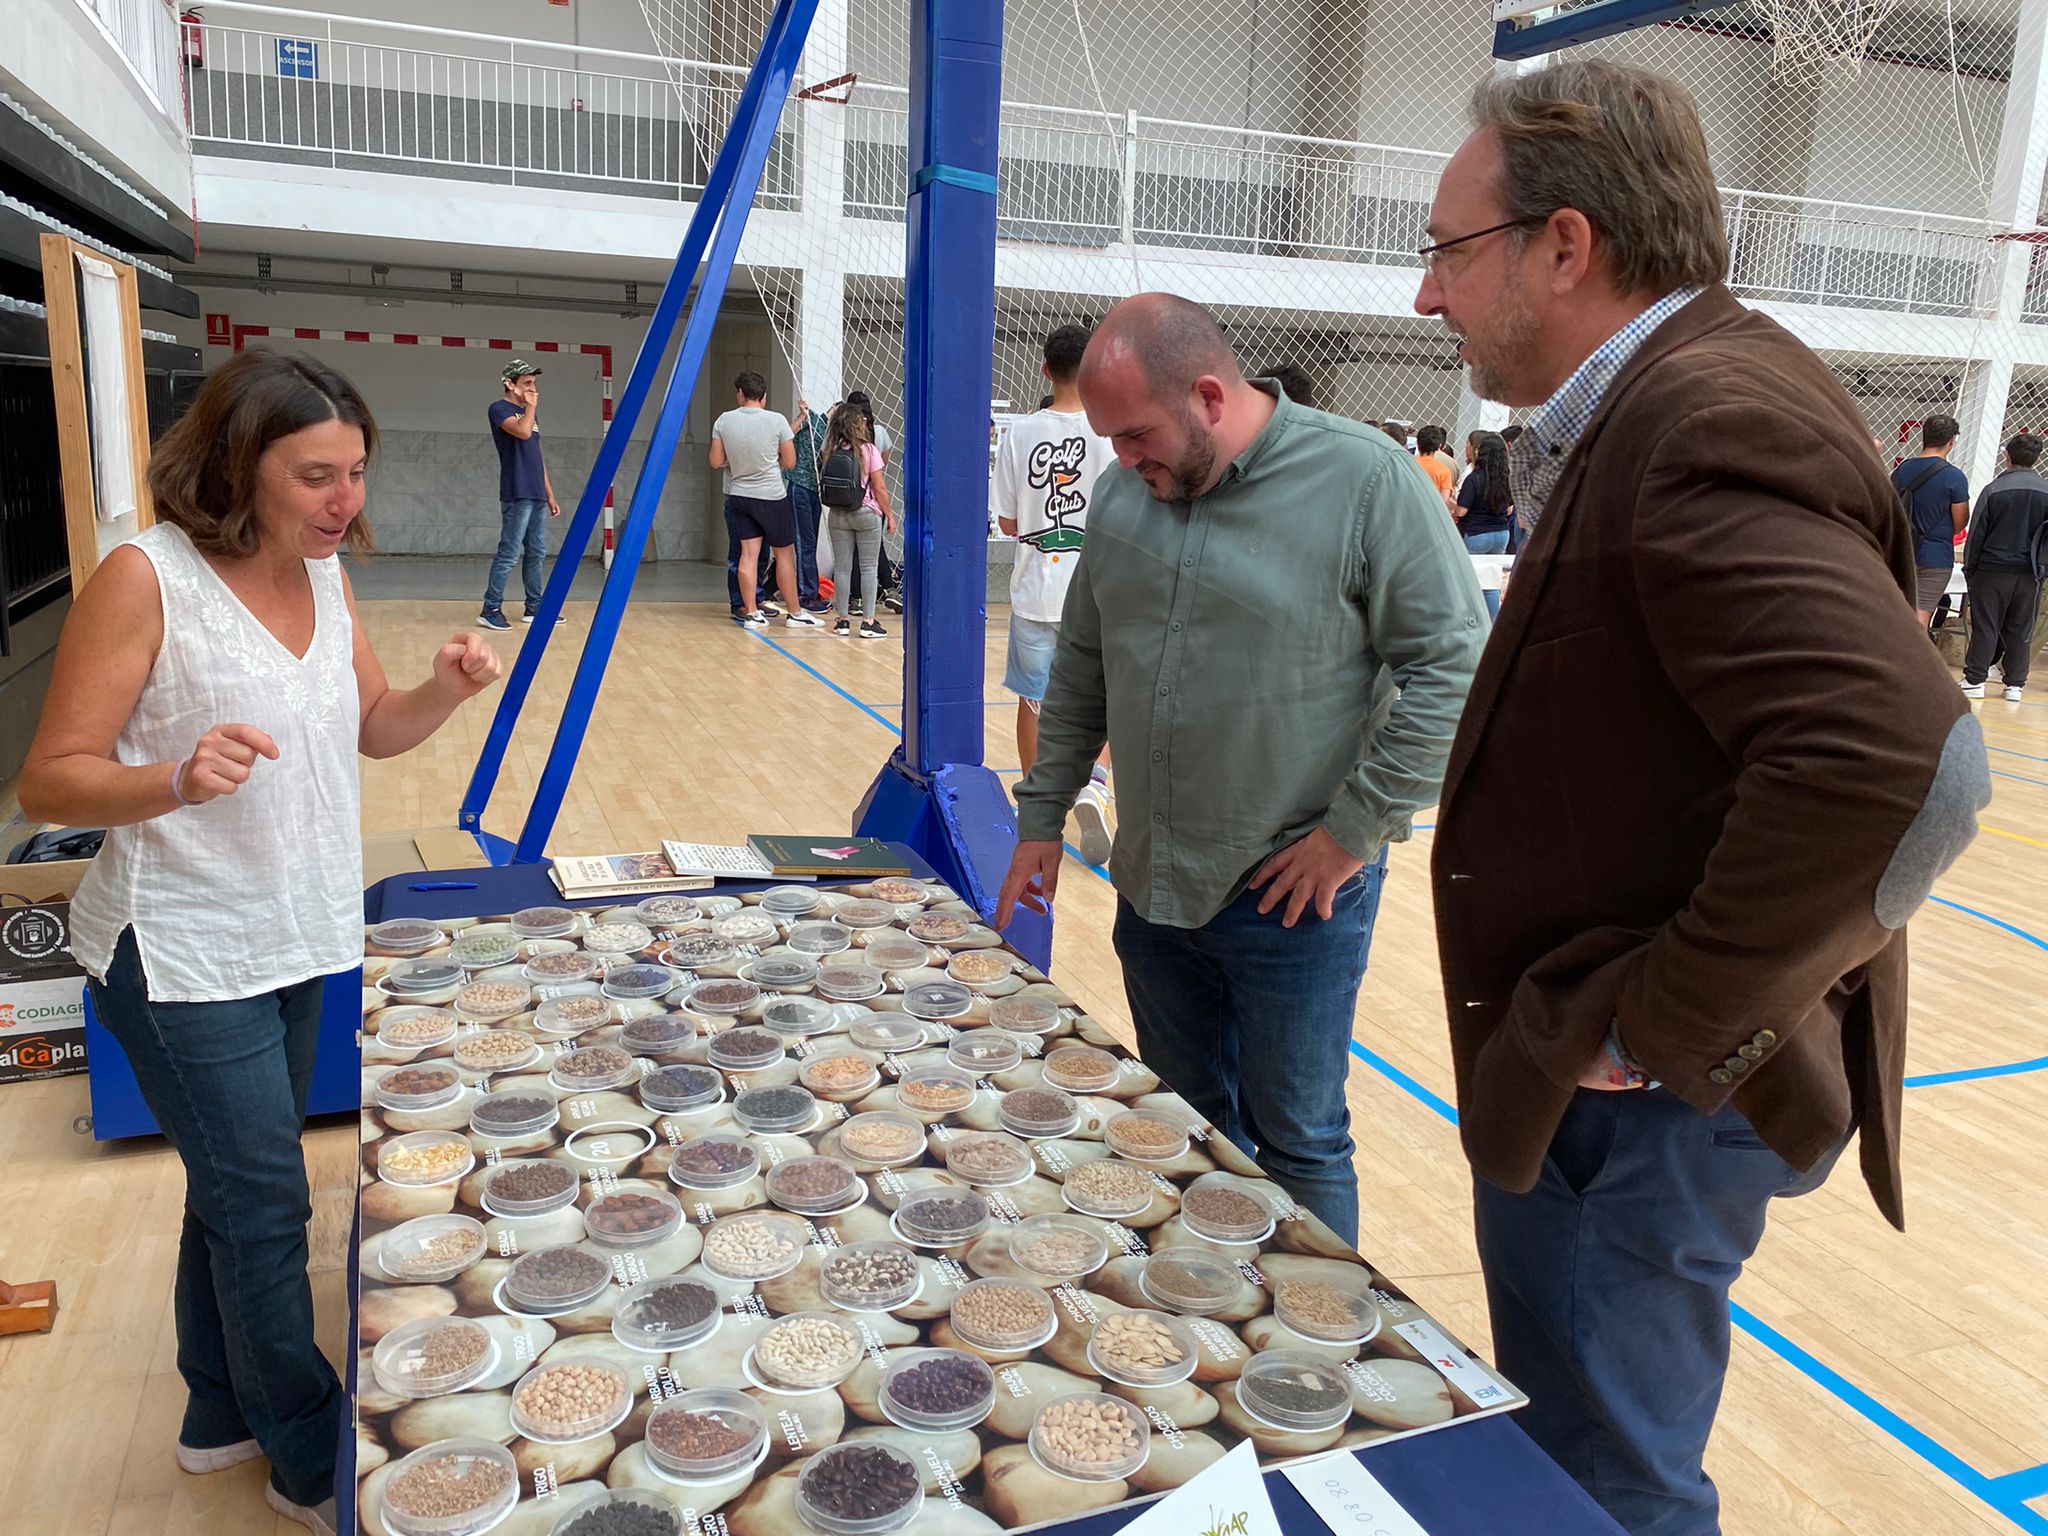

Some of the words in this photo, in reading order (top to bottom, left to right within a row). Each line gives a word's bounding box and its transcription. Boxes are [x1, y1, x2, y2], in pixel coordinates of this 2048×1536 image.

[1030, 438, 1085, 488] Golf
[1047, 492, 1085, 516] Club
[590, 1141, 610, 1156] 20
[1034, 1145, 1061, 1173] CALABAZA
[599, 1166, 614, 1194] OLORADO
[694, 1202, 709, 1224] HABAS
[985, 1195, 1009, 1224] CHOCHOS
[498, 1230, 511, 1256] CEBADA
[1104, 1225, 1136, 1259] CALABAZA
[624, 1252, 639, 1285] OLORADO
[940, 1254, 960, 1278] CARITA
[731, 1294, 752, 1327] LENTEJA
[1053, 1287, 1086, 1324] CHOCHOS
[1063, 1281, 1100, 1325] SILVESTRES
[513, 1335, 527, 1360] TRIGO
[856, 1319, 887, 1370] HABICHUELA
[1190, 1323, 1228, 1361] BUBANGO
[1201, 1321, 1240, 1359] AMARILLO
[643, 1364, 664, 1410] ARBANZO
[658, 1366, 677, 1399] RIOLLO
[1000, 1368, 1025, 1398] FRIJOL
[1340, 1362, 1381, 1402] LECHUGA
[1346, 1357, 1397, 1402] COLORADA
[781, 1409, 803, 1450] LENTEJA
[1144, 1405, 1184, 1450] CHOCHOS
[533, 1467, 549, 1500] TRIGO
[923, 1446, 964, 1511] HABICHUELA
[683, 1507, 702, 1536] ANZO
[702, 1514, 721, 1536] GRO
